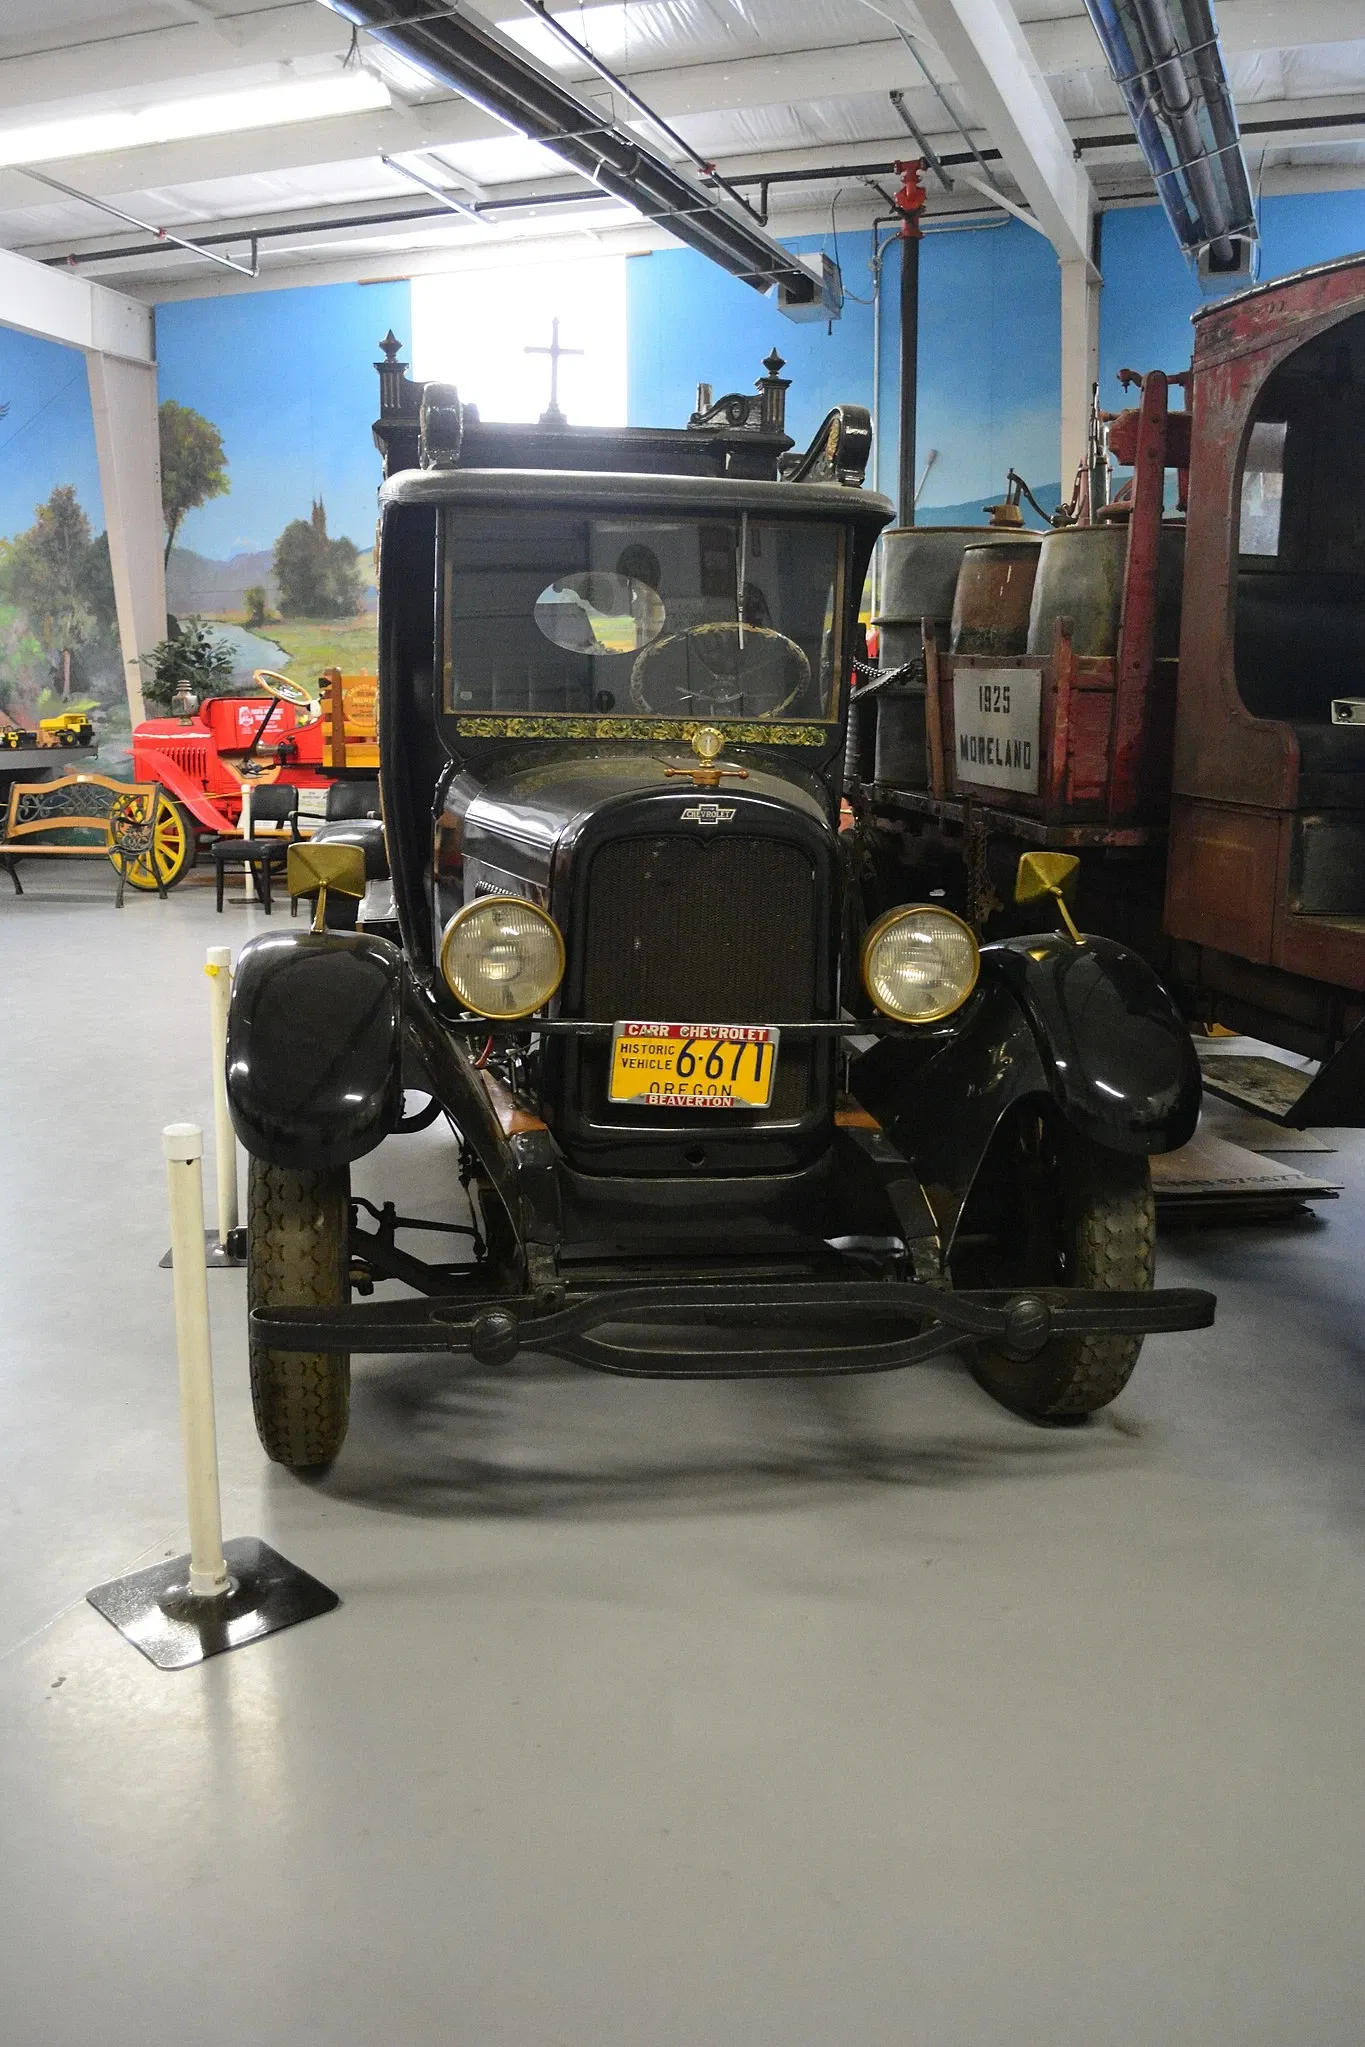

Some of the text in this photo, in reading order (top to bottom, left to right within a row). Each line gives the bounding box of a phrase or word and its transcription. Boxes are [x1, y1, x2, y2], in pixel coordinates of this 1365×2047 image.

[979, 685, 1010, 714] 1925
[960, 734, 1032, 770] MORELAND
[628, 1024, 767, 1041] CARR CHEVROLET
[620, 1043, 675, 1055] HISTORIC
[621, 1058, 673, 1070] VEHICLE
[649, 1081, 732, 1097] OREGON
[648, 1095, 732, 1106] BEAVERTON
